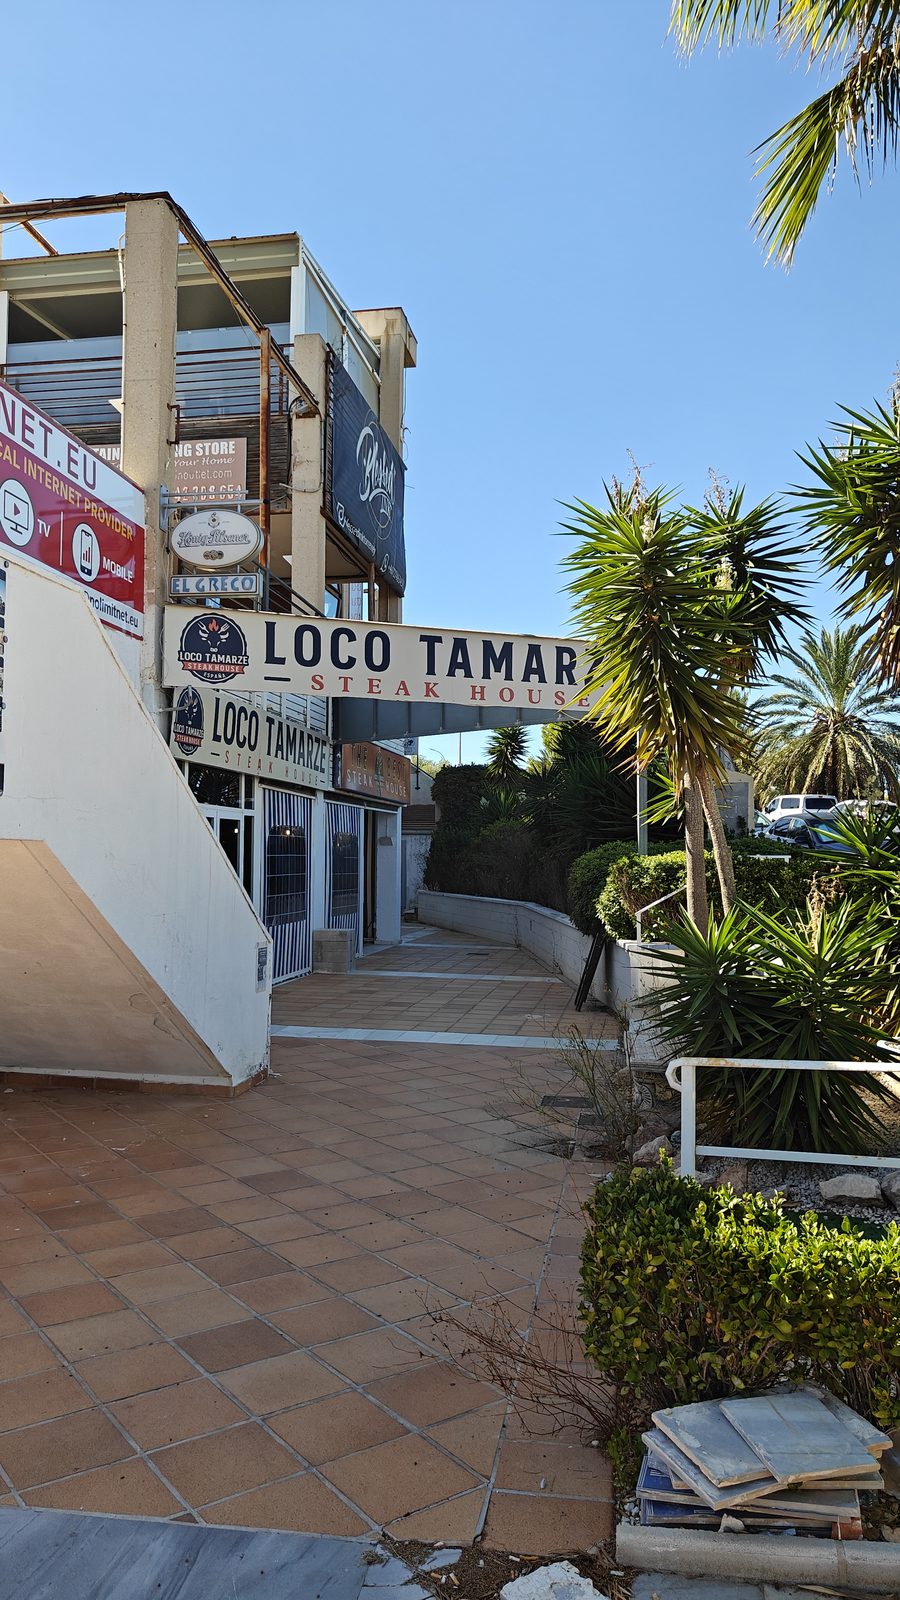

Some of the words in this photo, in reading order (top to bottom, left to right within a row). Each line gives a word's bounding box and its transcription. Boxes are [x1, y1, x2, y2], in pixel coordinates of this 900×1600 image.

[174, 459, 199, 467] Your
[202, 456, 236, 466] Home
[195, 441, 236, 456] STORE
[0, 441, 20, 470] AL
[24, 456, 81, 508] INTERNET
[84, 496, 133, 542] PROVIDER
[37, 518, 51, 538] TV
[102, 556, 133, 584] MOBILE
[172, 578, 190, 593] EL
[195, 577, 254, 592] GRECO
[180, 651, 202, 661] LOCO
[205, 653, 249, 665] TAMARZE
[264, 621, 391, 672] LOCO
[419, 634, 618, 688] TAMAR
[311, 674, 440, 699] STEAK
[470, 684, 590, 707] HOUSE
[212, 697, 259, 752] LOCO
[266, 716, 327, 774] TAMARZE
[225, 750, 273, 774] STEAK
[285, 768, 319, 786] HOUSE
[346, 769, 373, 788] STEAK
[385, 780, 407, 798] HOUSE
